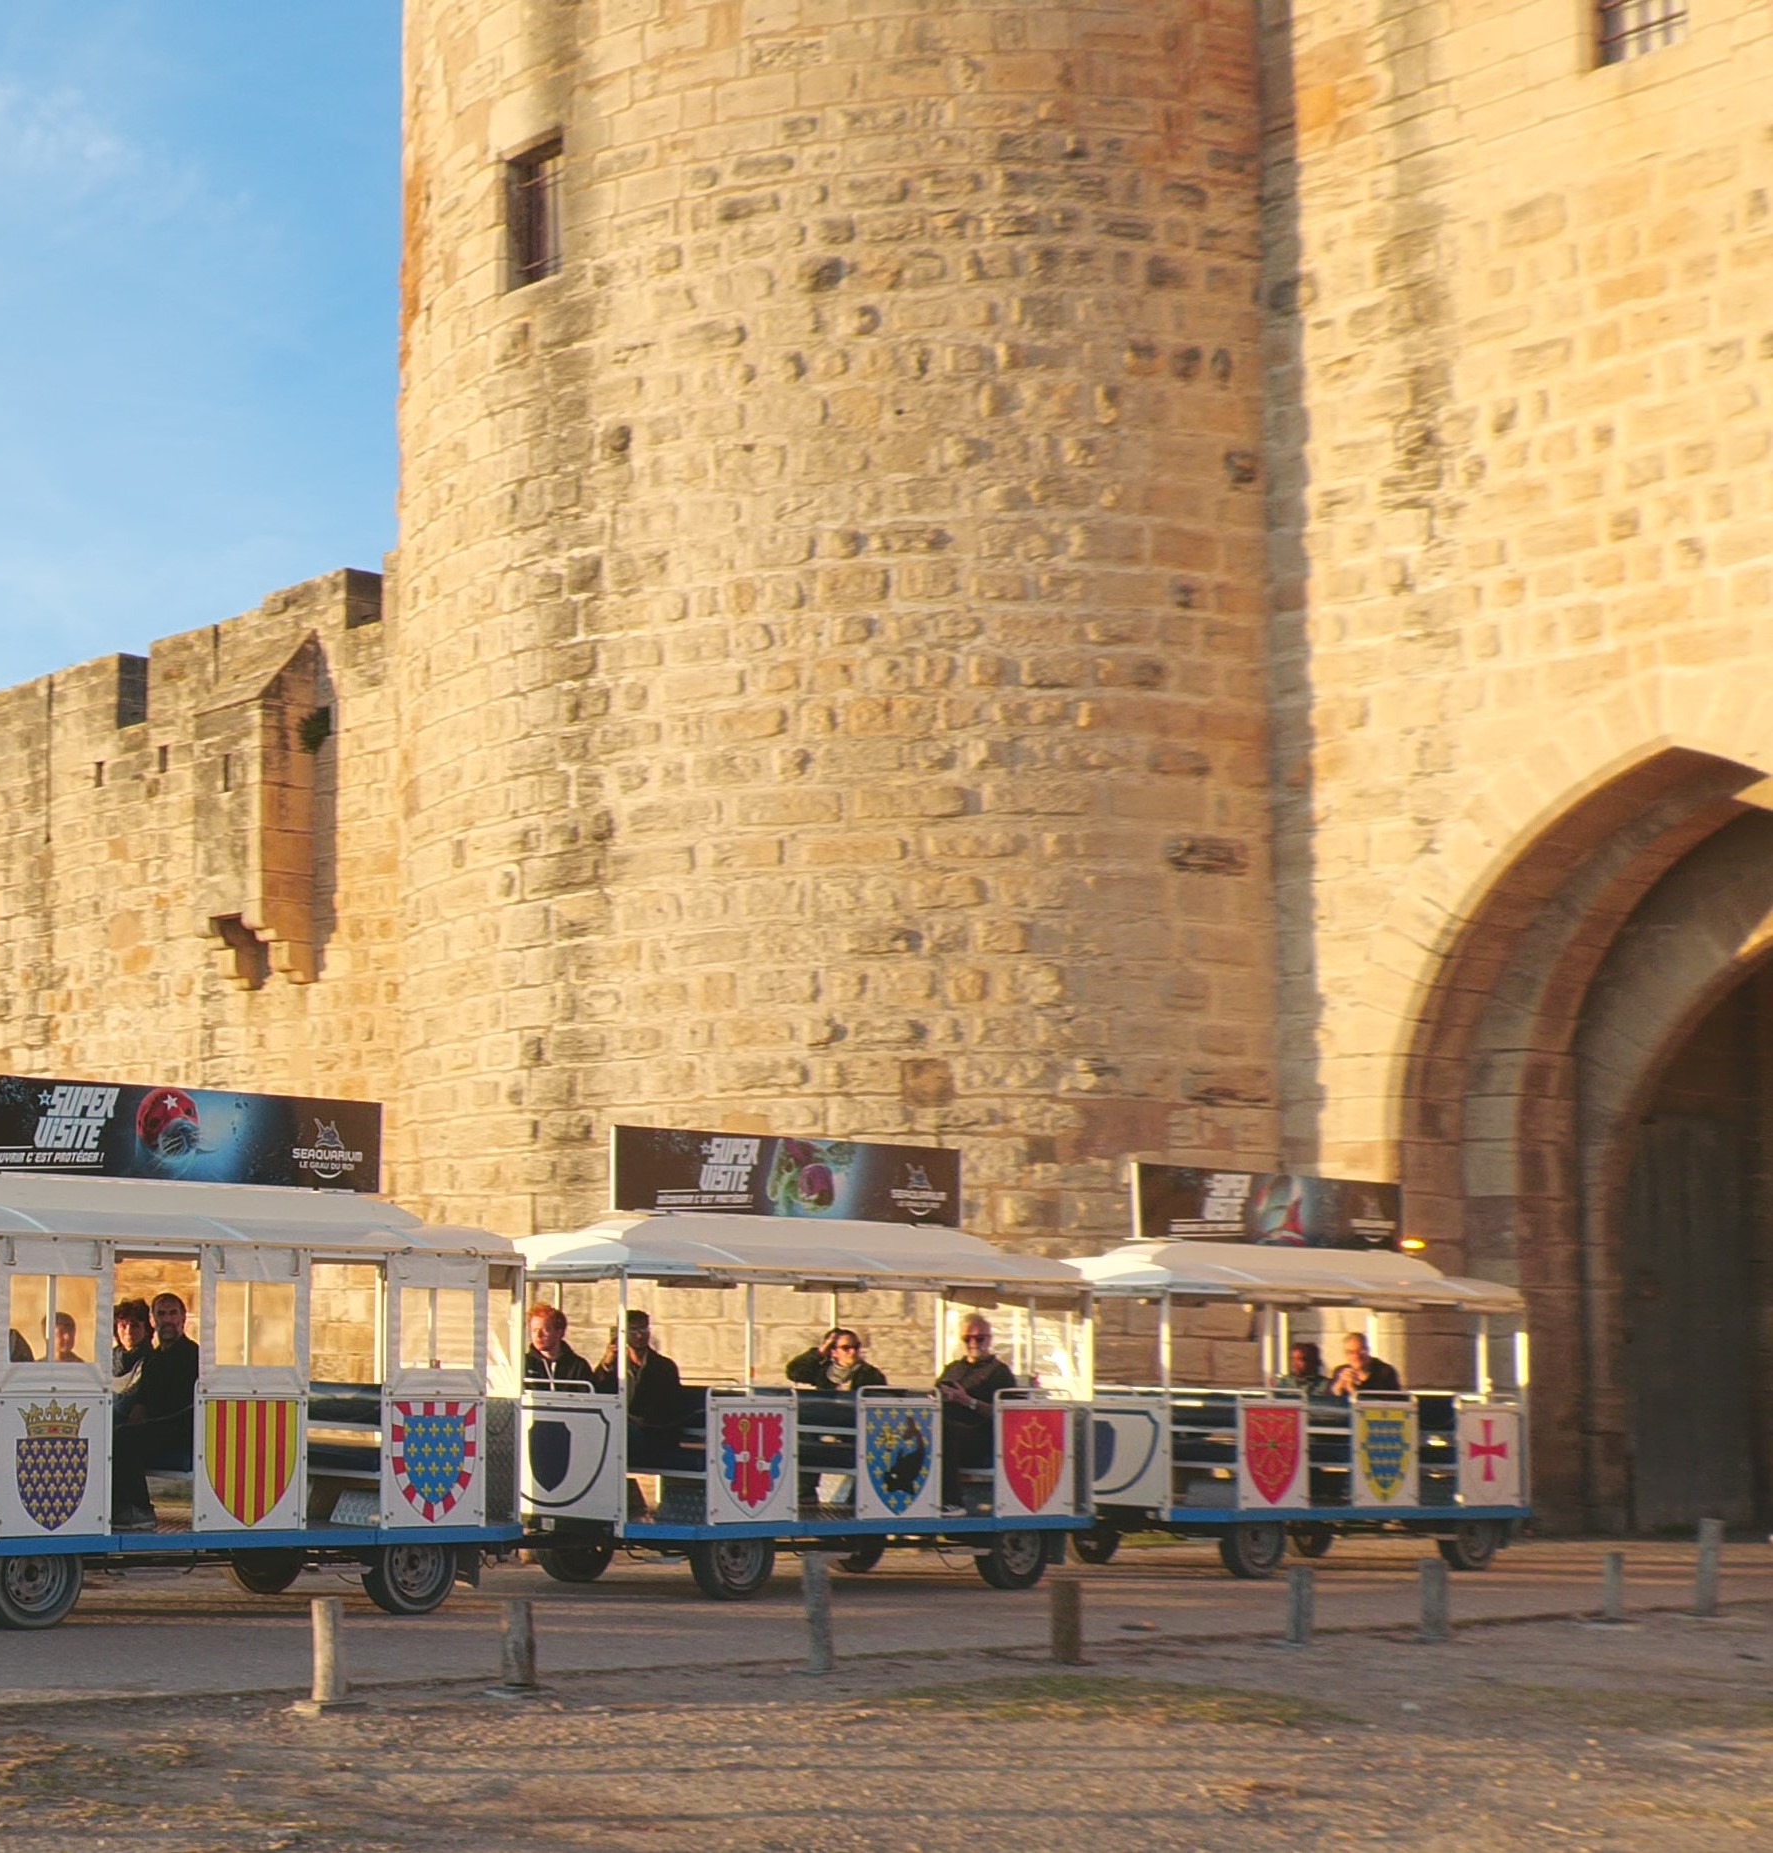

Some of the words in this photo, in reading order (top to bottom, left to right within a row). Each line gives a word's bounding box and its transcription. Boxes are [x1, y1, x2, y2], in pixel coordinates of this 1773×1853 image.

[46, 1085, 120, 1118] SUPER
[26, 1151, 54, 1163] C'EST
[53, 1150, 100, 1163] PROTÉGER
[292, 1148, 363, 1162] SEAQUARIUM
[707, 1137, 761, 1165] SUPER
